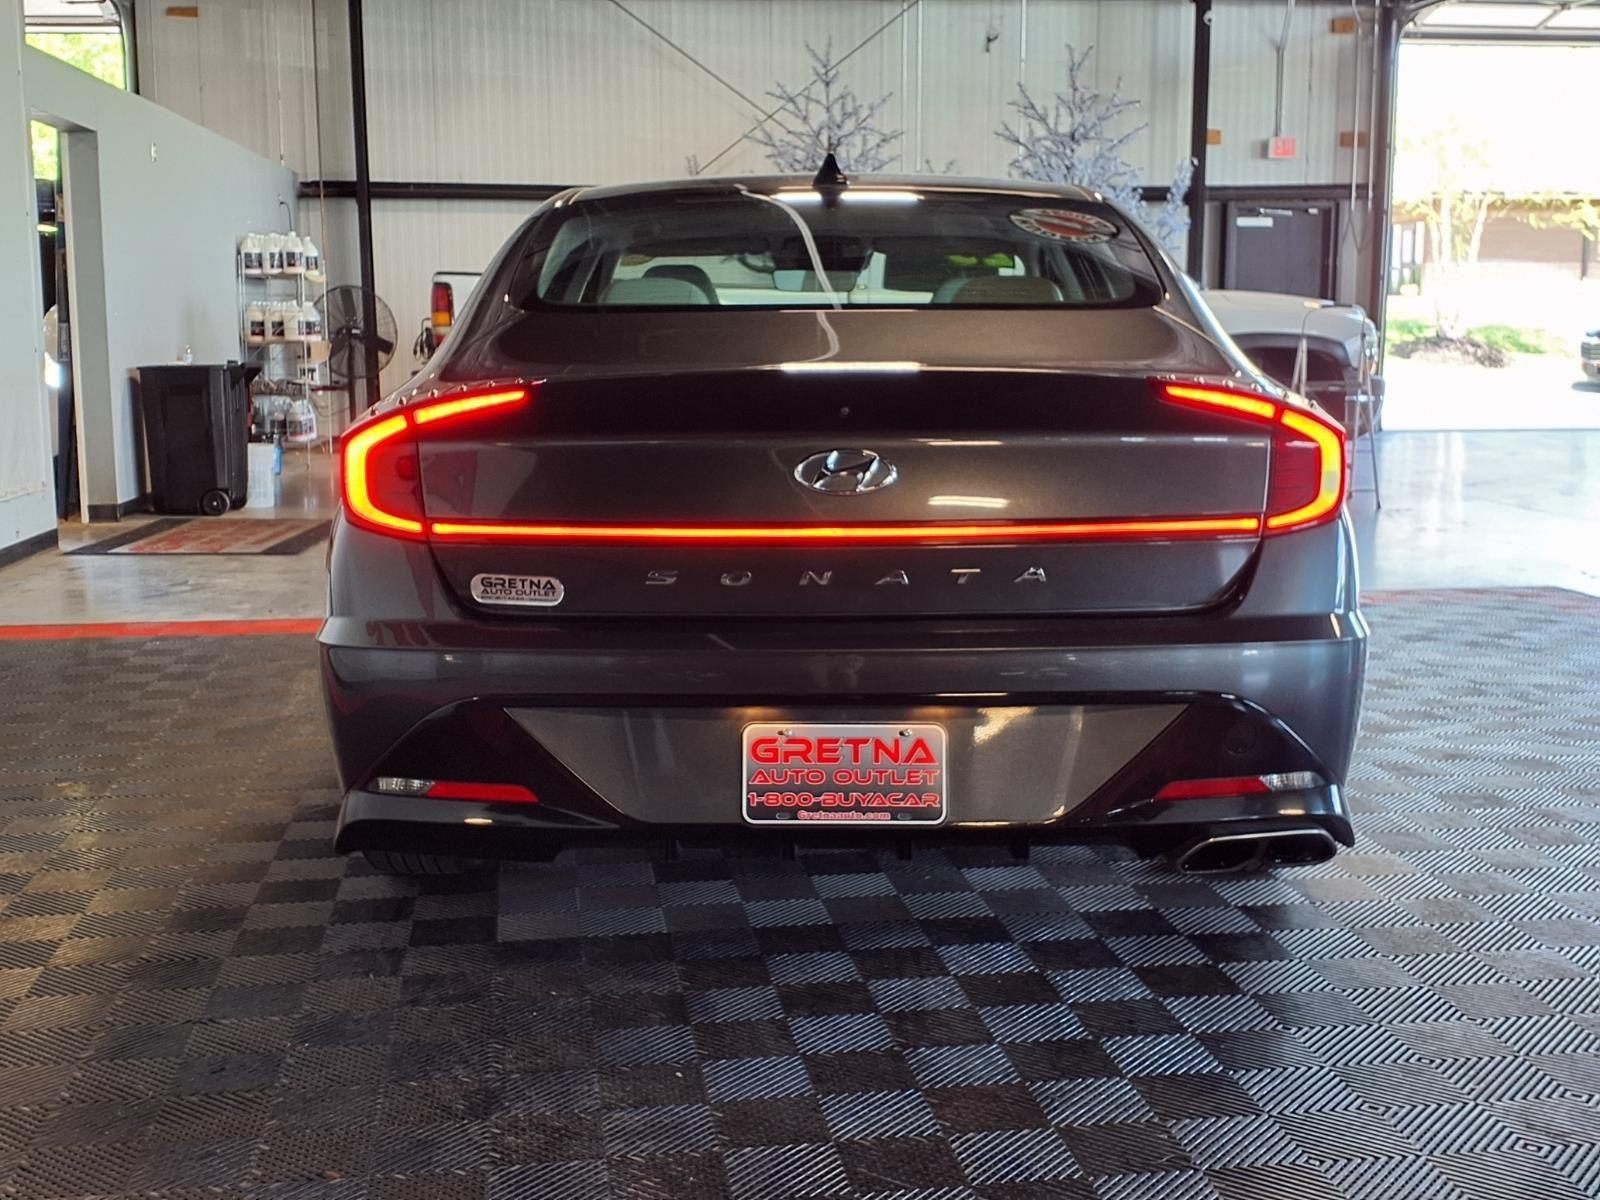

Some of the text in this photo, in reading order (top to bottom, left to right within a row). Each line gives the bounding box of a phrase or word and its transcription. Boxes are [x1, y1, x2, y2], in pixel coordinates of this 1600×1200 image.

[481, 576, 556, 590] GRETNA
[645, 566, 1047, 585] SONATA
[481, 588, 557, 597] AUTO OUTLET
[751, 737, 938, 765] GRETNA
[749, 769, 940, 785] AUTO OUTLET
[748, 792, 940, 808] 1-800-BUYACAR
[797, 810, 891, 820] Gretnaauto.com
